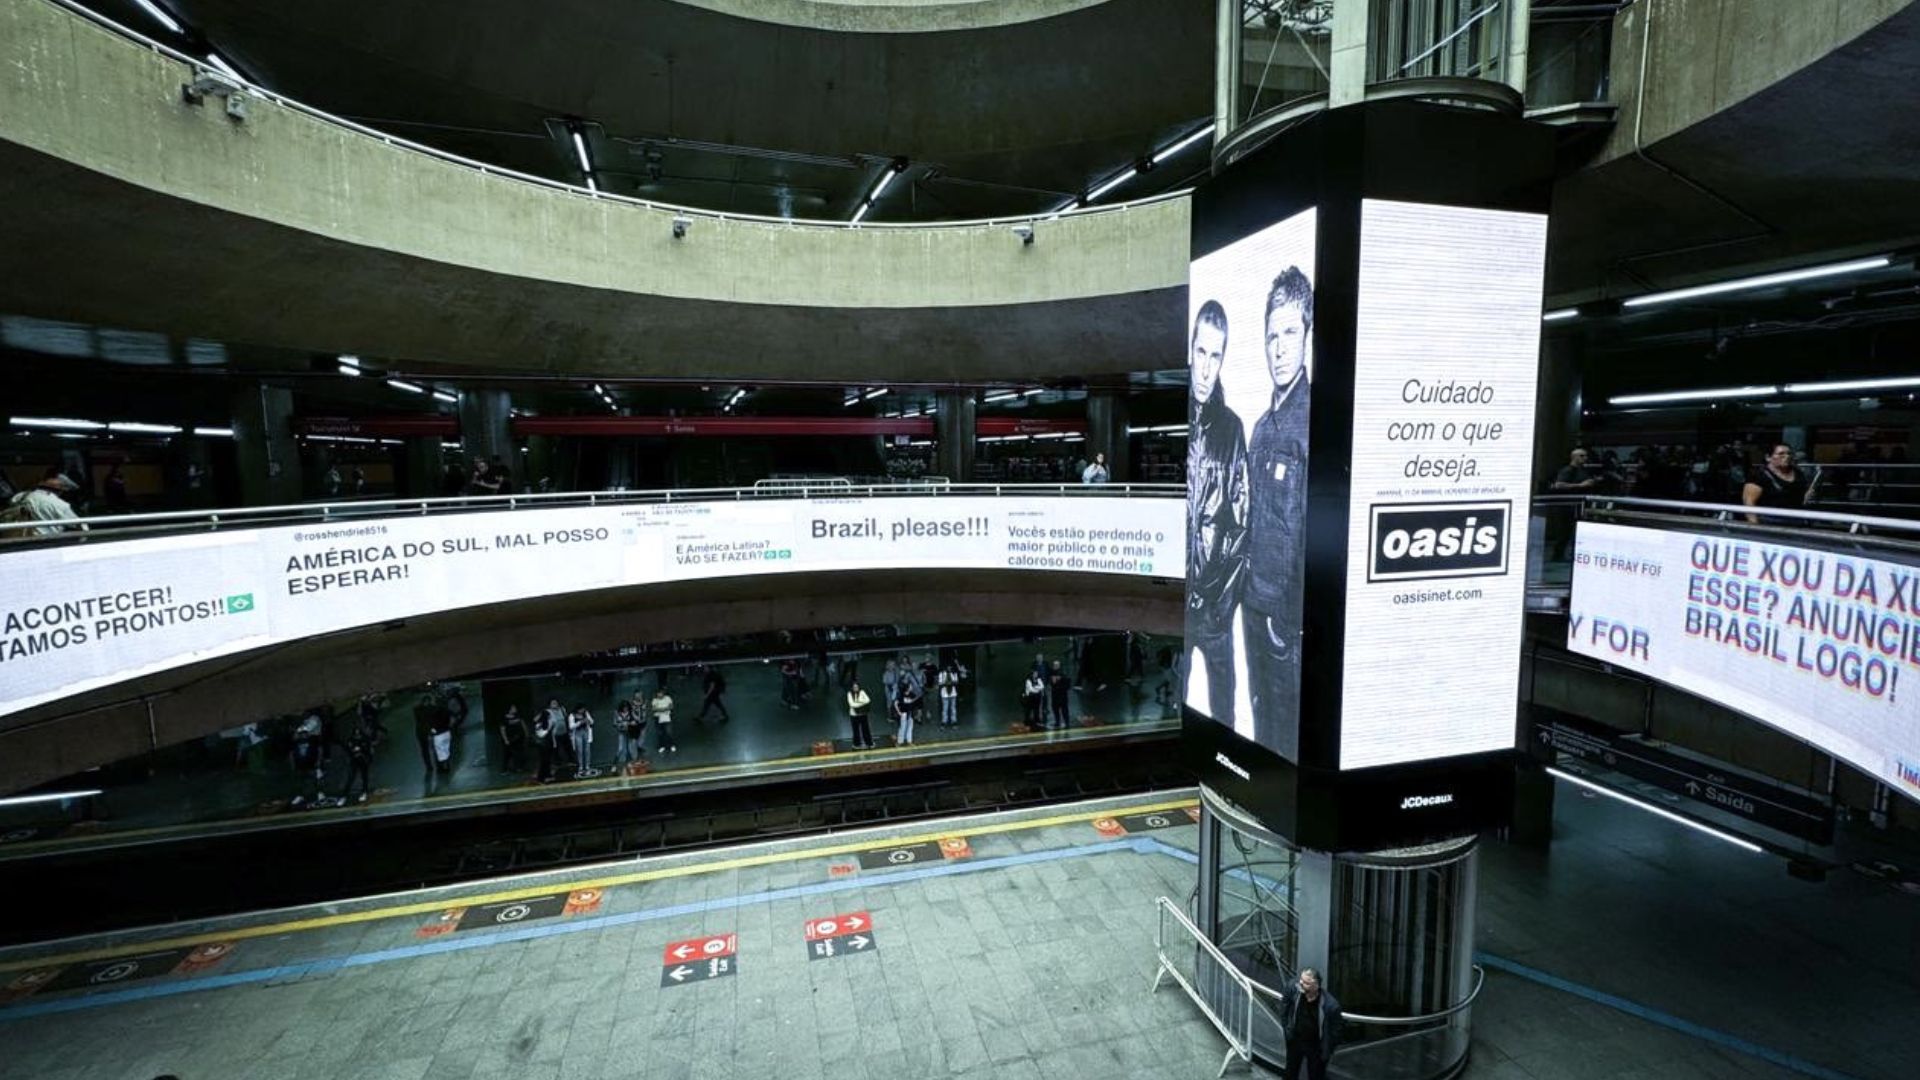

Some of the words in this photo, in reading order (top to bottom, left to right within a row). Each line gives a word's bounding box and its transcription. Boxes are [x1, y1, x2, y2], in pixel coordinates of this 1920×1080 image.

[1402, 379, 1494, 404] Cuidado
[1387, 421, 1435, 441] com
[1442, 423, 1456, 440] o
[1462, 422, 1503, 446] que
[1404, 454, 1481, 483] deseja.
[812, 518, 883, 541] Brazil,
[892, 517, 989, 541] please!!!
[1008, 526, 1046, 538] Vocês
[1050, 527, 1085, 539] estão
[1089, 529, 1151, 542] perdendo
[1155, 532, 1164, 542] o
[1383, 517, 1498, 560] oasis
[286, 546, 396, 573] AMÉRICA
[403, 540, 435, 558] DO
[442, 537, 489, 554] SUL,
[495, 533, 538, 549] MAL
[544, 527, 608, 544] POSSO
[676, 553, 701, 565] VÃO
[704, 553, 718, 563] SE
[722, 550, 763, 562] FAZER?
[687, 541, 730, 553] América
[733, 540, 770, 551] Latina?
[1008, 541, 1044, 552] maior
[1048, 542, 1095, 555] público
[1099, 545, 1107, 554] e
[1111, 546, 1119, 555] o
[1123, 545, 1154, 557] mais
[1008, 555, 1063, 567] caloroso
[1067, 556, 1083, 567] do
[1087, 558, 1138, 571] mundo!
[1573, 552, 1590, 564] ED
[1594, 555, 1608, 567] TO
[1610, 557, 1639, 573] PRAY
[1691, 541, 1750, 575] QUE
[1758, 550, 1824, 590] XOU
[1834, 562, 1877, 605] DA
[288, 563, 409, 595] ESPERAR!
[1393, 588, 1482, 604] oasisinet.com
[1688, 574, 1780, 618] ESSE?
[4, 586, 173, 634] ACONTECER!
[96, 599, 224, 640] PRONTOS!!
[1591, 619, 1650, 661] FOR
[1685, 606, 1787, 661] BRASIL
[1797, 636, 1898, 703] LOGO!
[1896, 761, 1920, 789] TIM
[1400, 794, 1454, 809] JCDecaux
